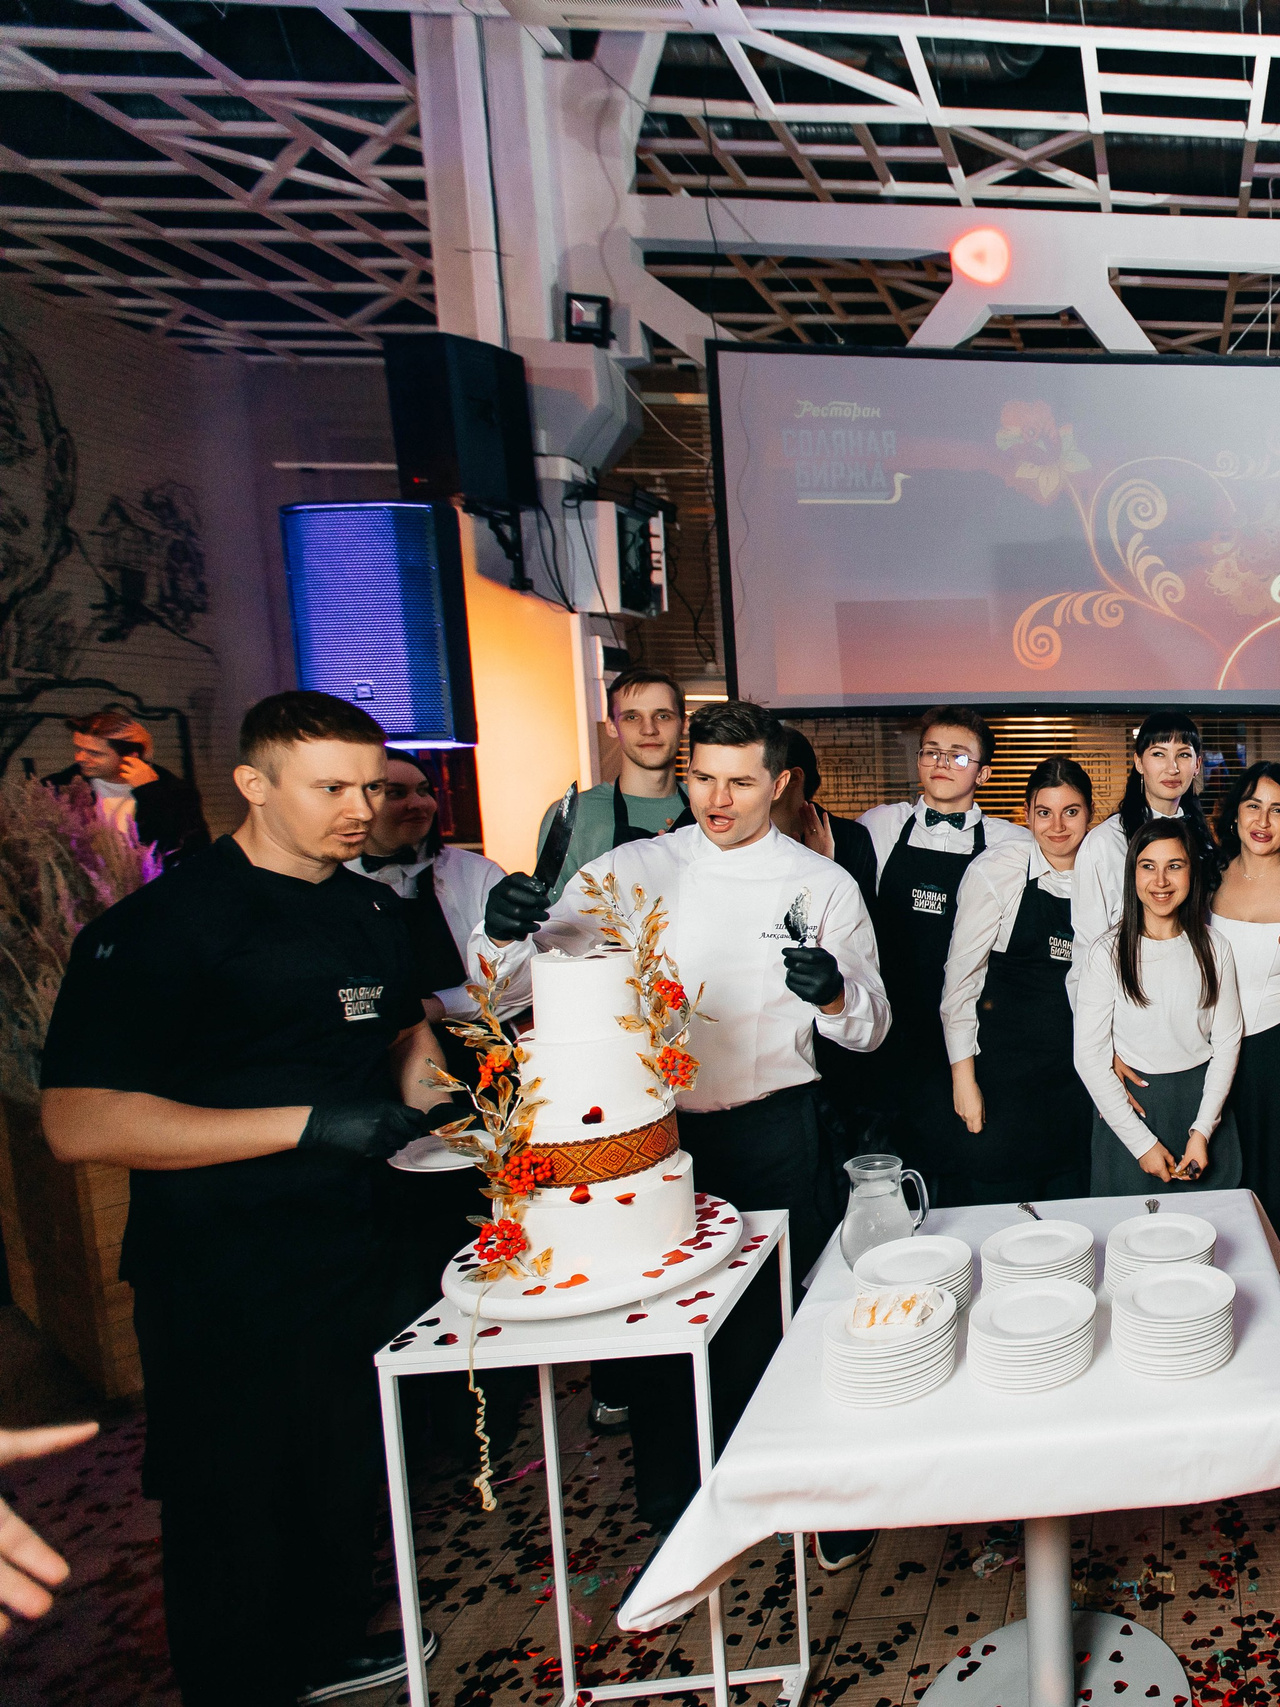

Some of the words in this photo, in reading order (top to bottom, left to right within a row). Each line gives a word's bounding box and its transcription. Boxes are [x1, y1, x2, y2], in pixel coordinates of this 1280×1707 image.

[795, 400, 881, 421] Ресторан
[781, 429, 897, 458] СОЛЯНАЯ
[912, 889, 947, 903] СОЛЯНАЯ
[914, 899, 942, 911] БИРЖА
[1049, 936, 1073, 950] СОЛЯН
[1050, 946, 1072, 958] БИРЖ
[338, 986, 384, 1002] СОЛЯНАЯ
